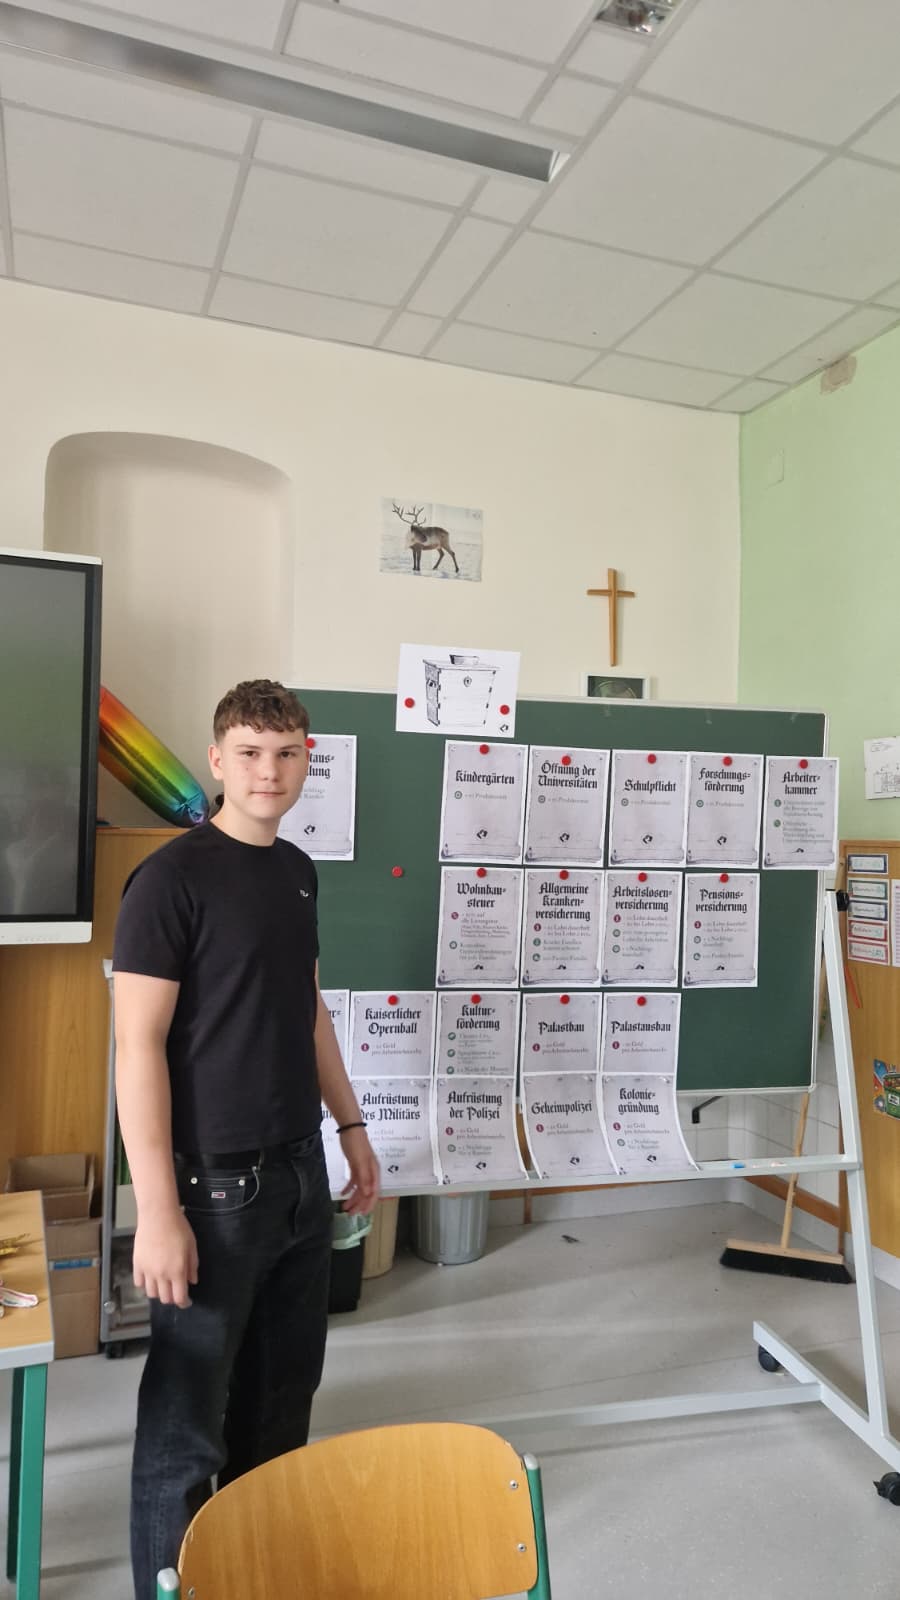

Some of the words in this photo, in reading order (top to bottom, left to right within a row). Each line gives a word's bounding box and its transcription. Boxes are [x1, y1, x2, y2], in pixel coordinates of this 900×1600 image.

[541, 760, 580, 778] Öffnung
[582, 766, 597, 776] der
[455, 769, 515, 786] Kindergärten
[538, 775, 598, 789] Universitäten
[624, 779, 677, 794] Schulpflicht
[704, 781, 745, 795] förderung
[539, 882, 590, 896] Allgemeine
[467, 899, 495, 908] steuer
[615, 899, 669, 912] versicherung
[695, 902, 748, 914] versicherung
[535, 908, 591, 922] versicherung
[365, 1008, 422, 1020] Kaiserlicher
[368, 1022, 418, 1037] Opernball
[456, 1018, 501, 1032] förderung
[538, 1021, 585, 1035] Palastbau
[611, 1020, 671, 1034] Palastausbau
[361, 1092, 419, 1107] Aufrüstung
[447, 1090, 503, 1106] Aufrüstung
[378, 1107, 421, 1121] Militärs
[449, 1107, 464, 1119] der
[466, 1106, 501, 1121] Polizei
[531, 1101, 593, 1116] Geheimpolizei
[618, 1102, 660, 1116] gründung
